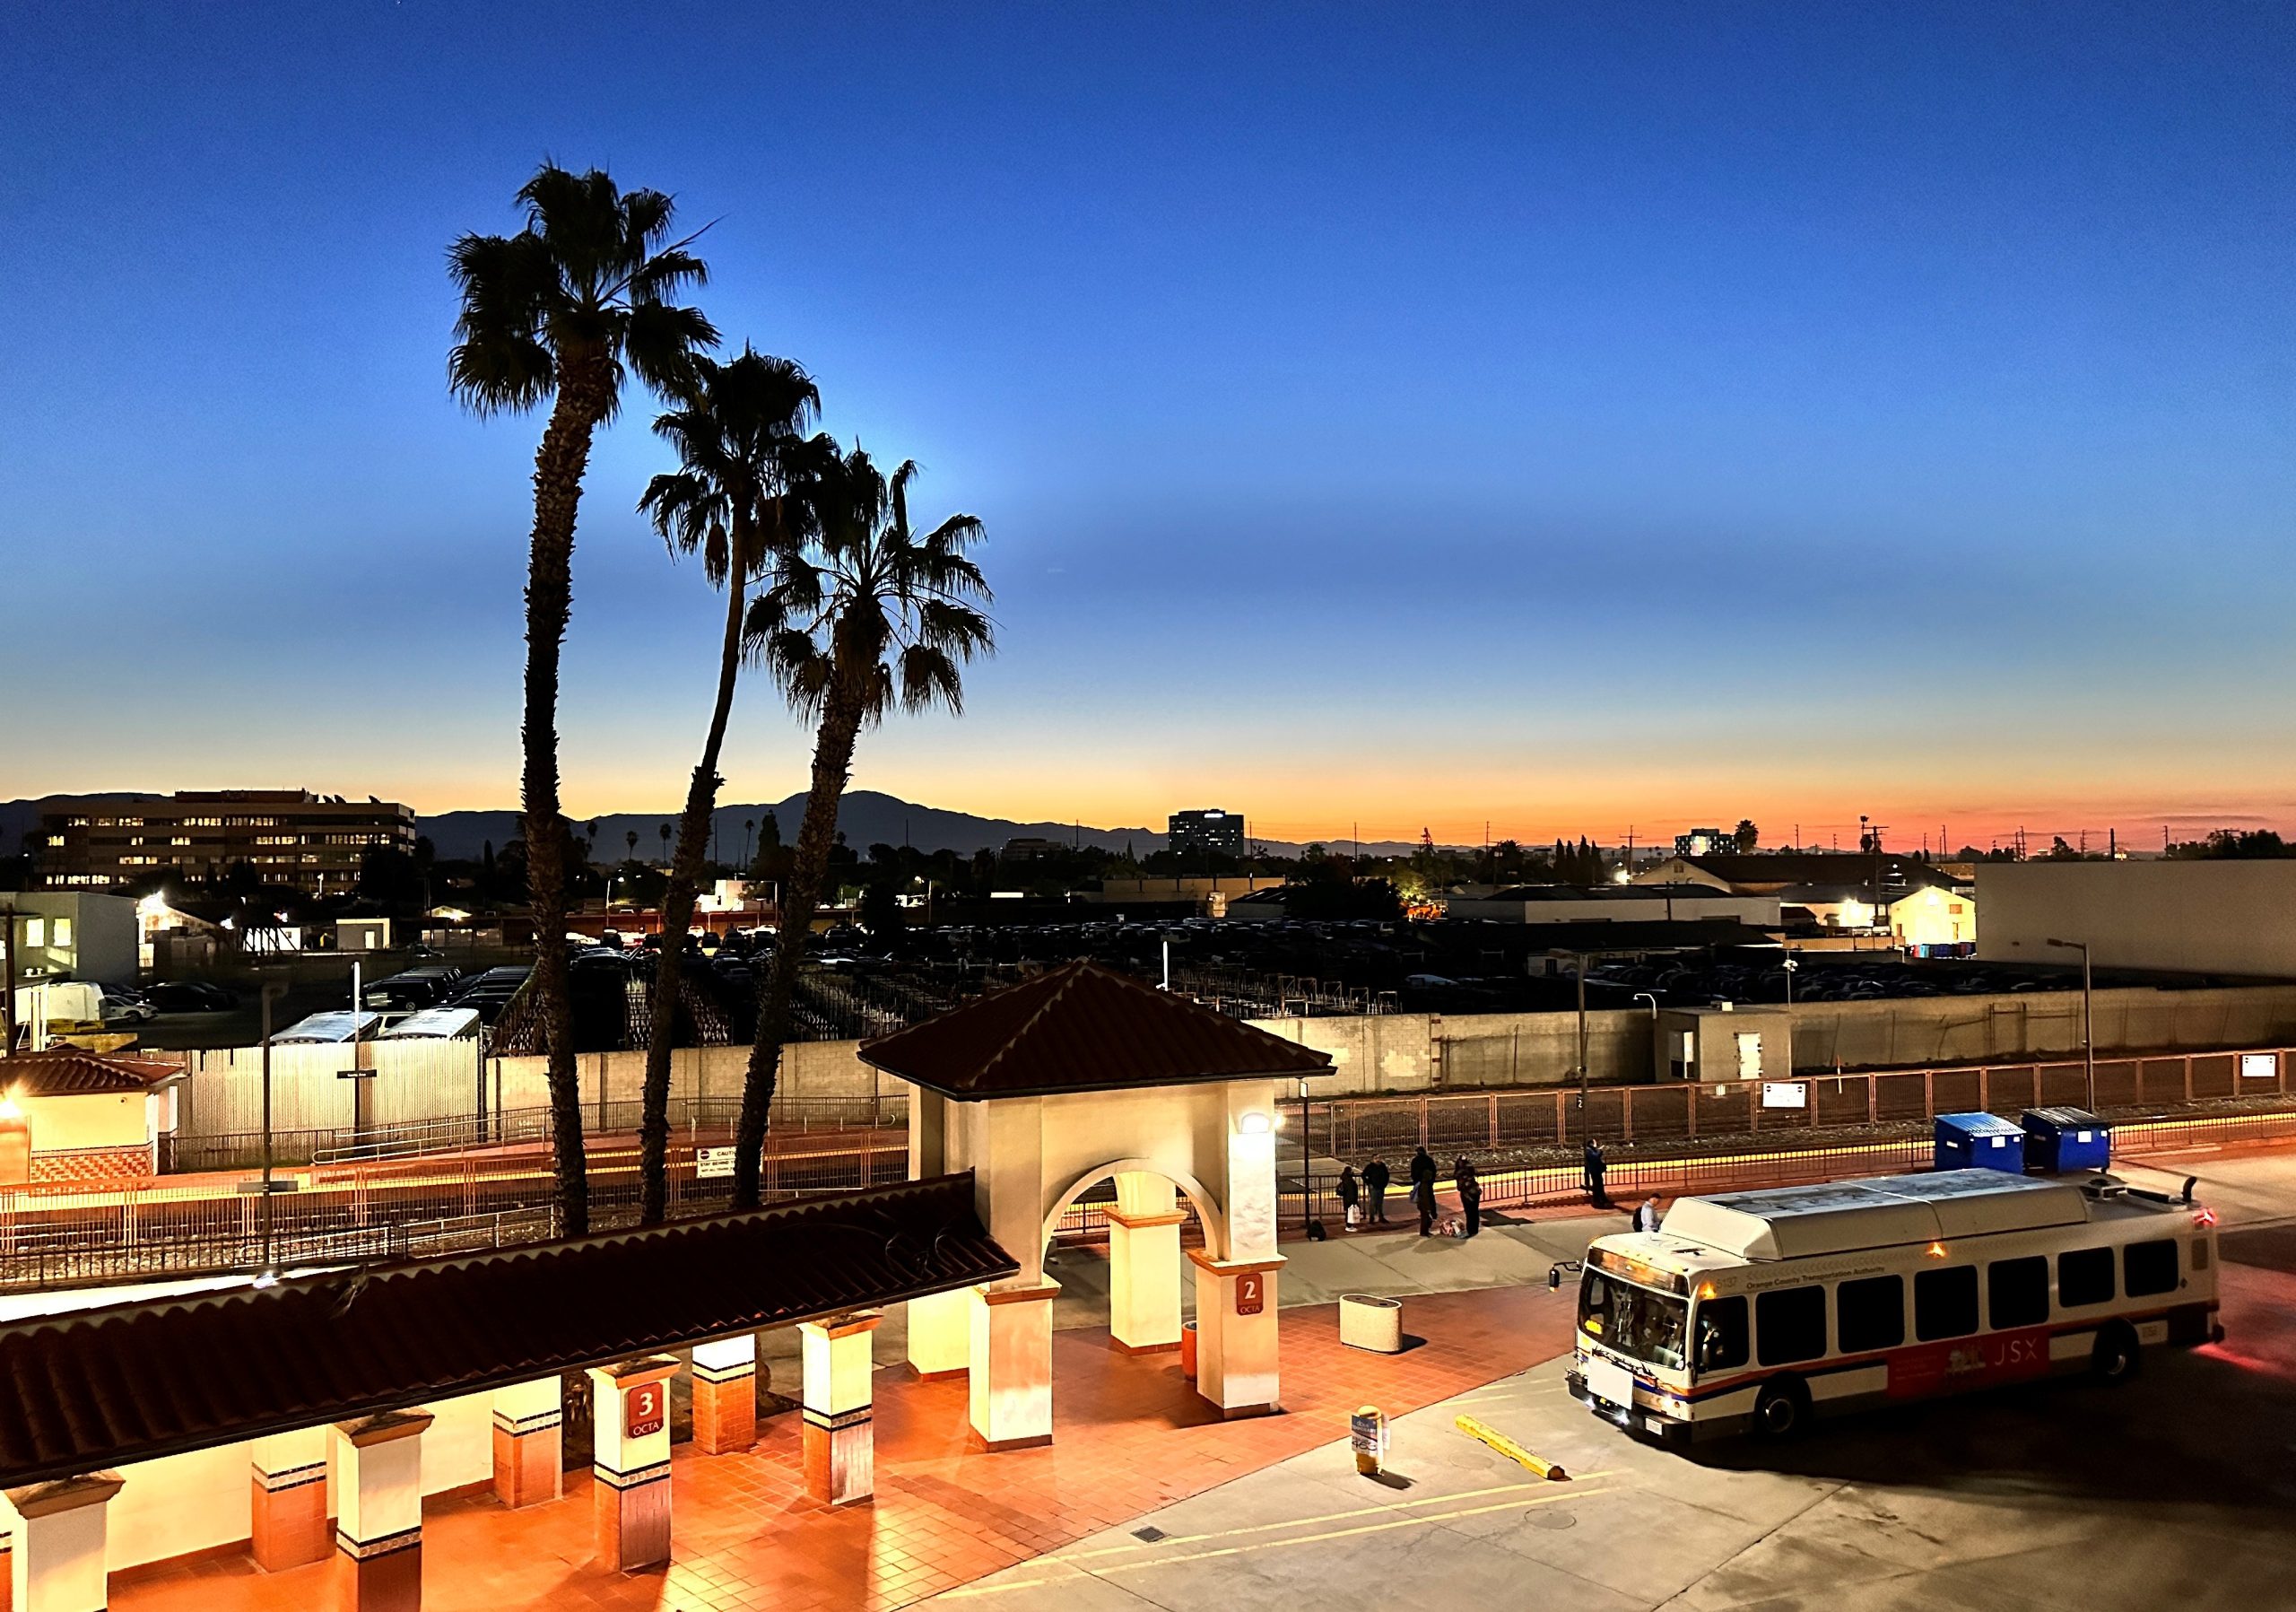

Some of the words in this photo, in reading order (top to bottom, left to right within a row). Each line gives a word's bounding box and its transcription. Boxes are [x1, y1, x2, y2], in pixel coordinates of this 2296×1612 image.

[1578, 1099, 1583, 1108] 2
[1746, 1281, 1773, 1290] Orange
[1774, 1277, 1800, 1285] County
[1802, 1270, 1853, 1281] Transportation
[1854, 1266, 1885, 1276] Authority
[1244, 1281, 1257, 1300] 2
[1239, 1305, 1260, 1313] OCTA
[1994, 1338, 2038, 1366] JSX
[639, 1391, 654, 1416] 3
[633, 1421, 660, 1435] OCTA
